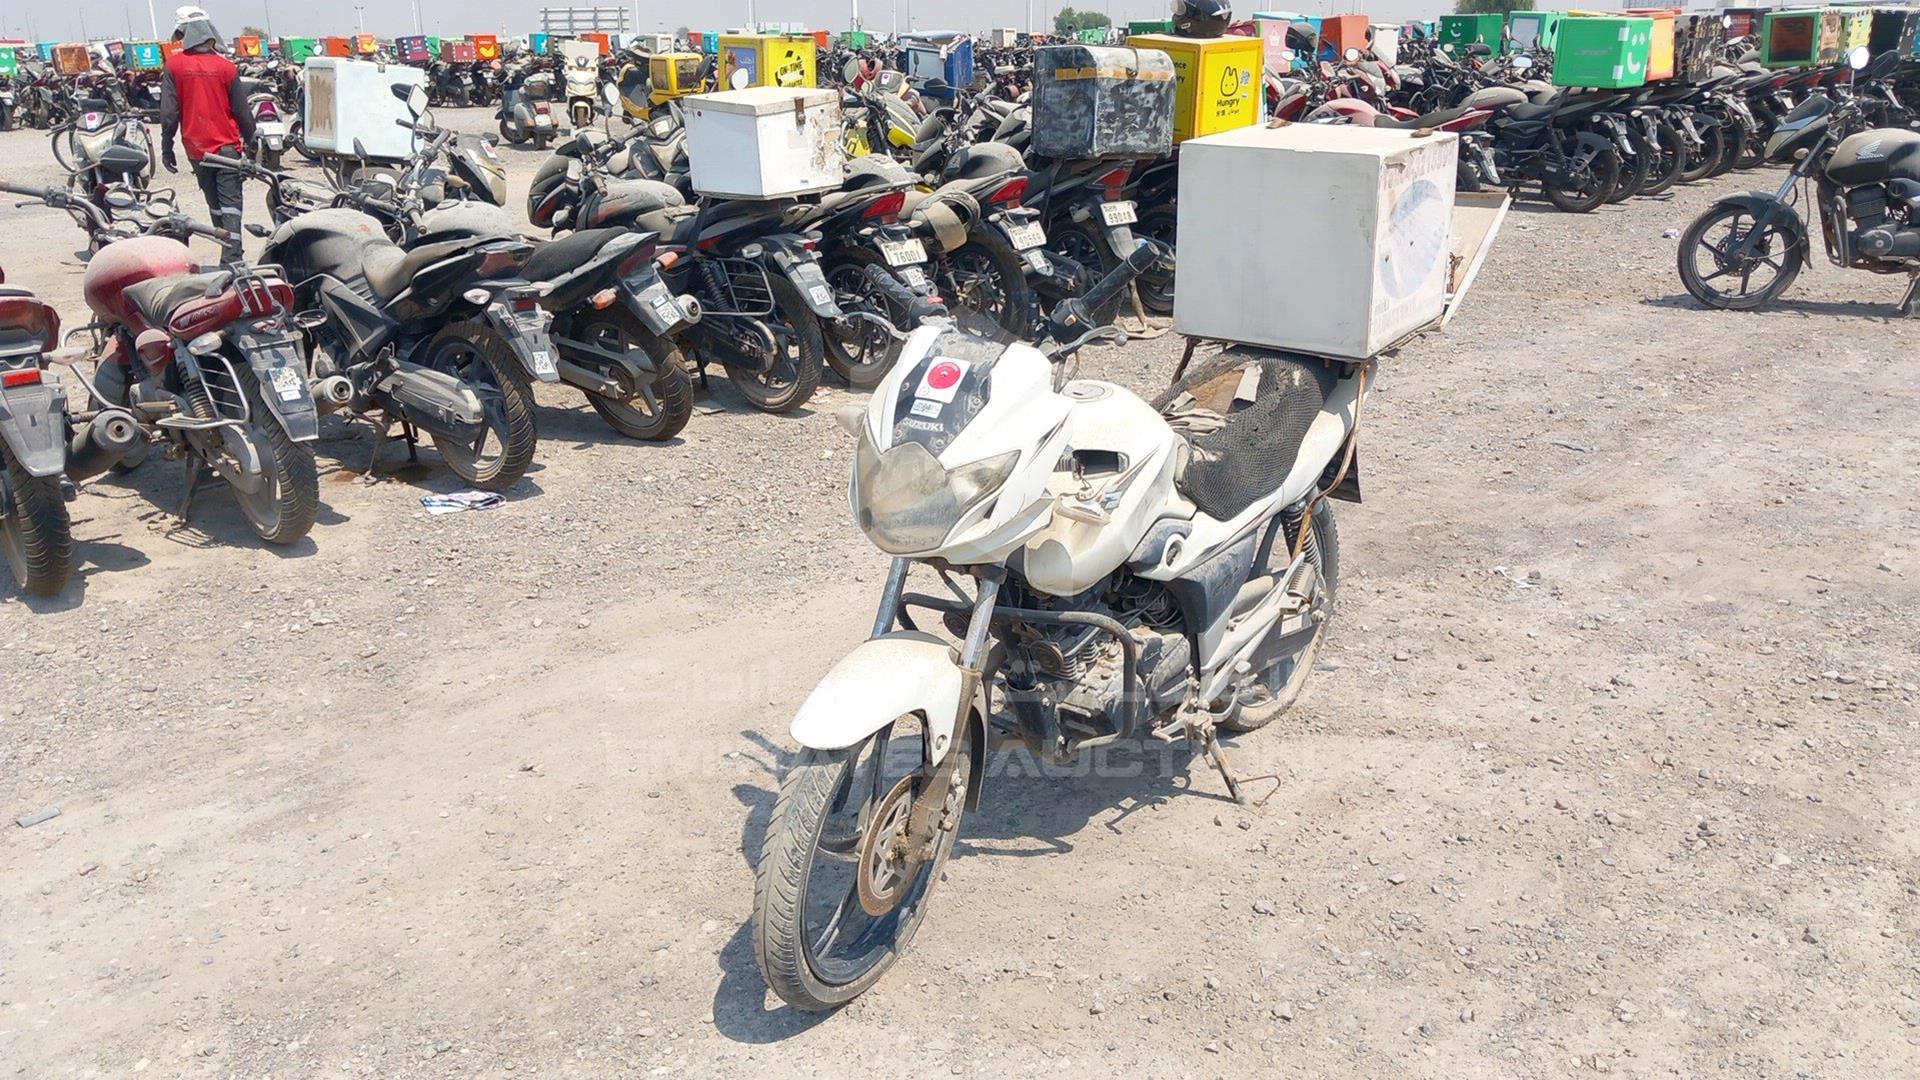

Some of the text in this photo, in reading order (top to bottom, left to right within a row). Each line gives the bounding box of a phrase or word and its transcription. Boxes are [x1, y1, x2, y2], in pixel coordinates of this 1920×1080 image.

[1216, 98, 1240, 108] Hungry
[893, 249, 922, 263] 76001
[902, 417, 944, 432] SUZUKI
